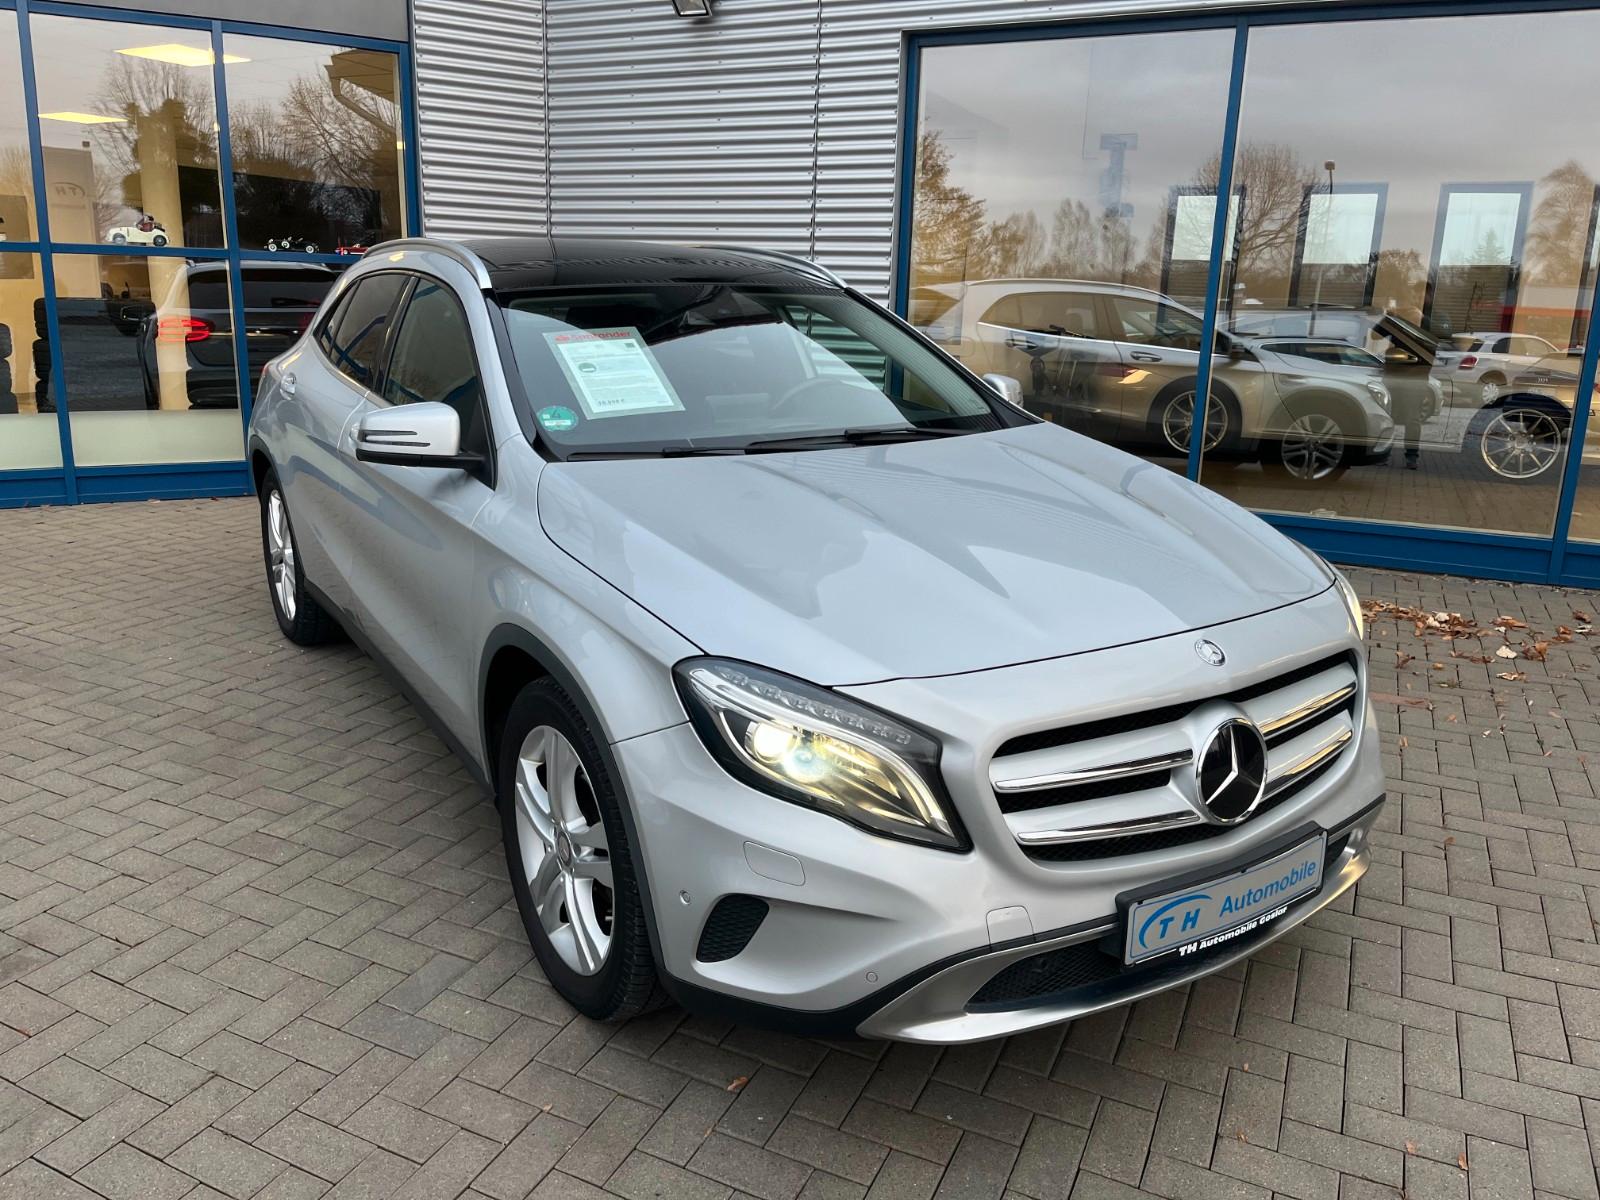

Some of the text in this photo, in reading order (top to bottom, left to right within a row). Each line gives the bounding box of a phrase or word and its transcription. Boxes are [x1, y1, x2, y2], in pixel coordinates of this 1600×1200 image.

[1219, 861, 1317, 917] Automobile
[1178, 906, 1288, 957] TH Automobile Goslar
